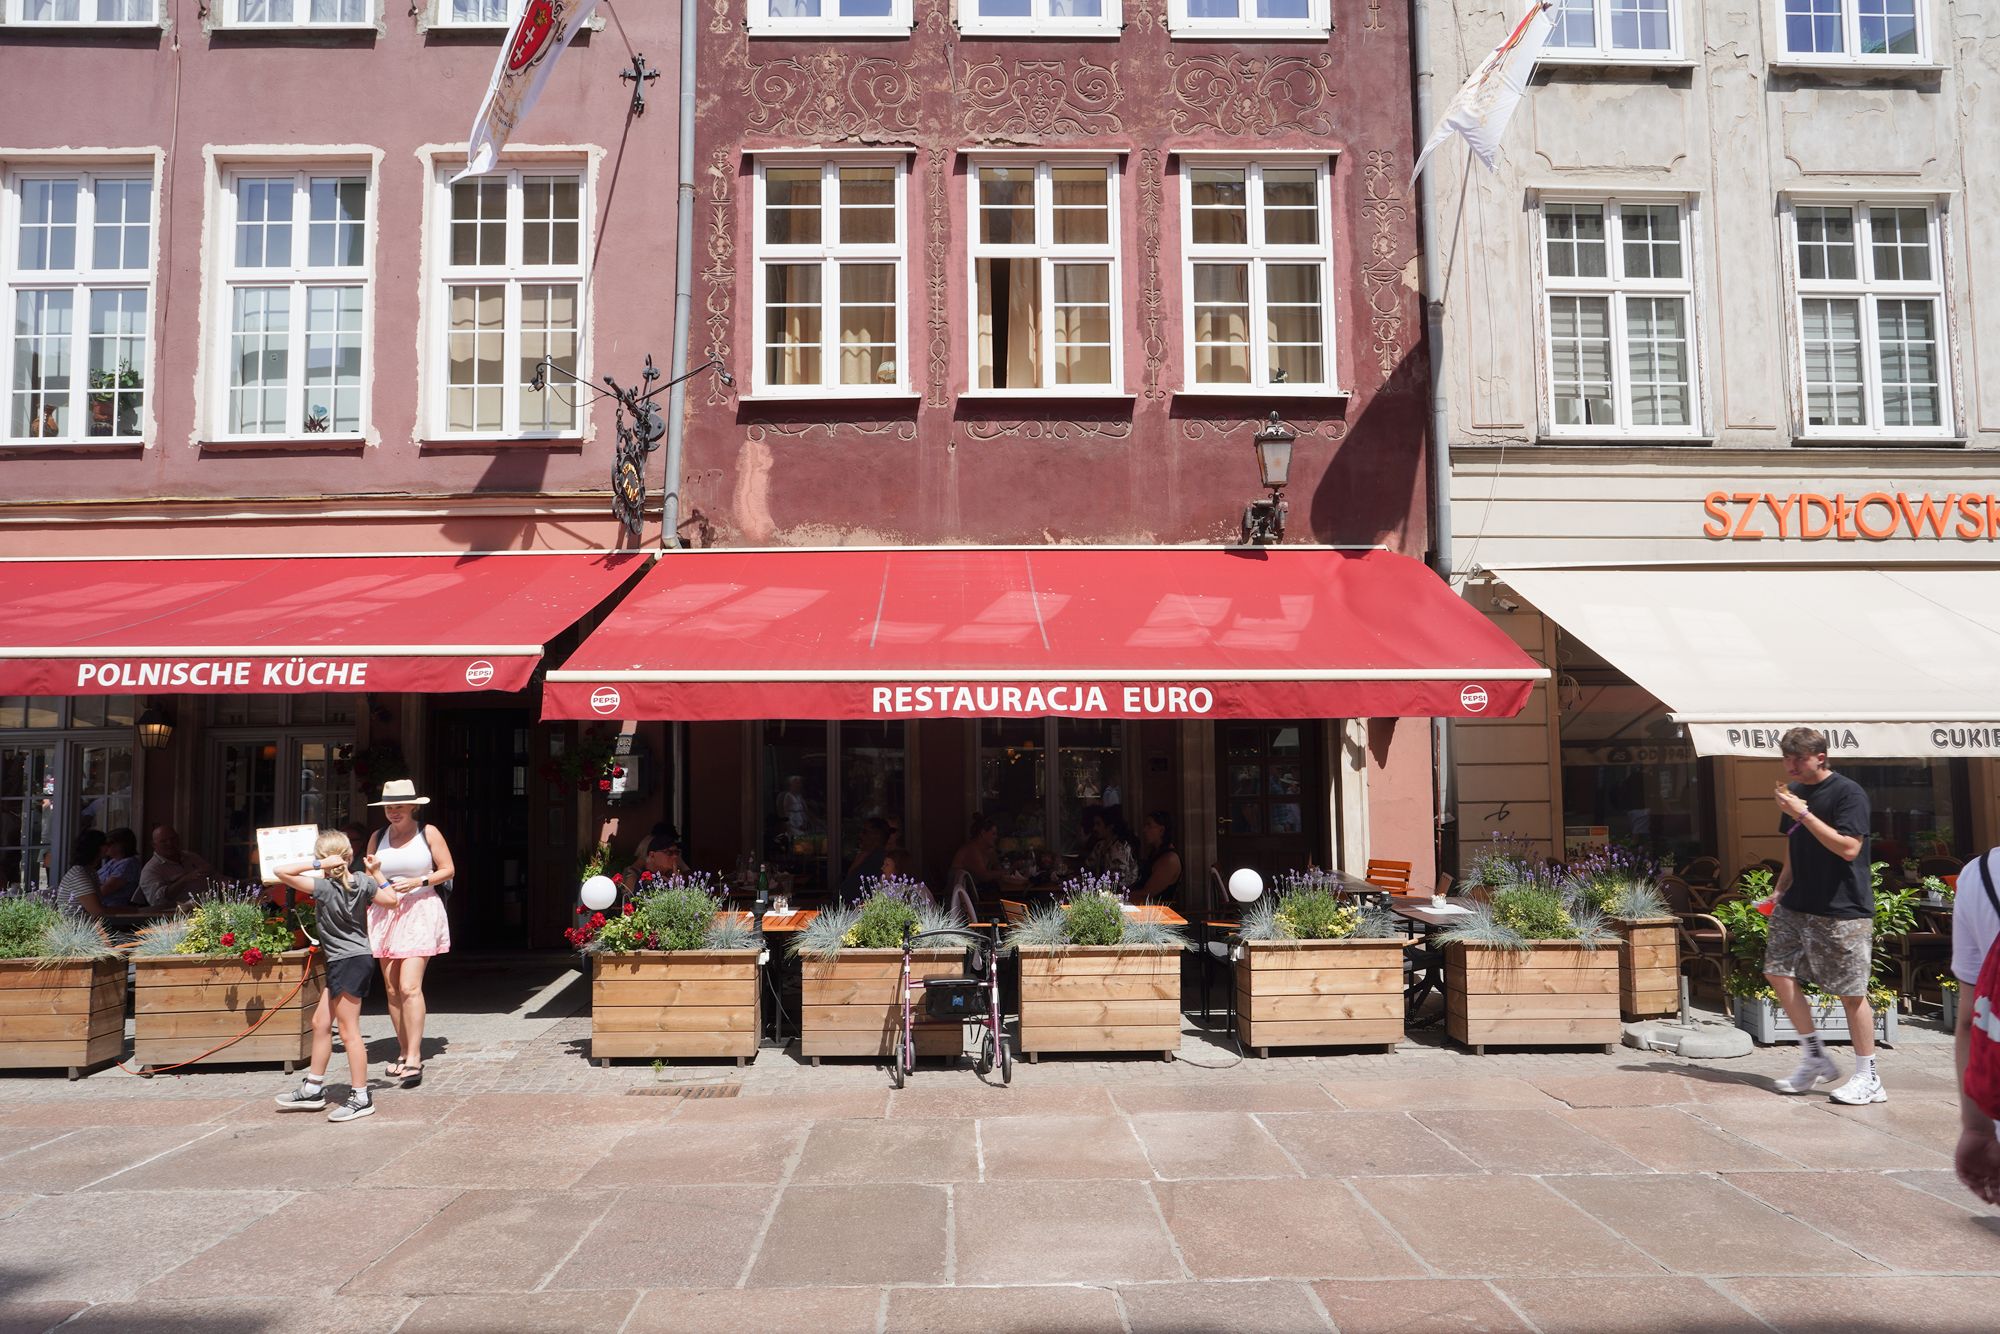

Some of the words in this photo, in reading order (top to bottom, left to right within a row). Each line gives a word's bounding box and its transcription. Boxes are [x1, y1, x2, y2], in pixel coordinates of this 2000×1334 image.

[77, 661, 251, 687] POLNISCHE
[263, 657, 368, 686] KÜCHE
[872, 686, 1108, 713] RESTAURACJA
[1123, 687, 1213, 713] EURO
[1931, 728, 2000, 749] CUKIE
